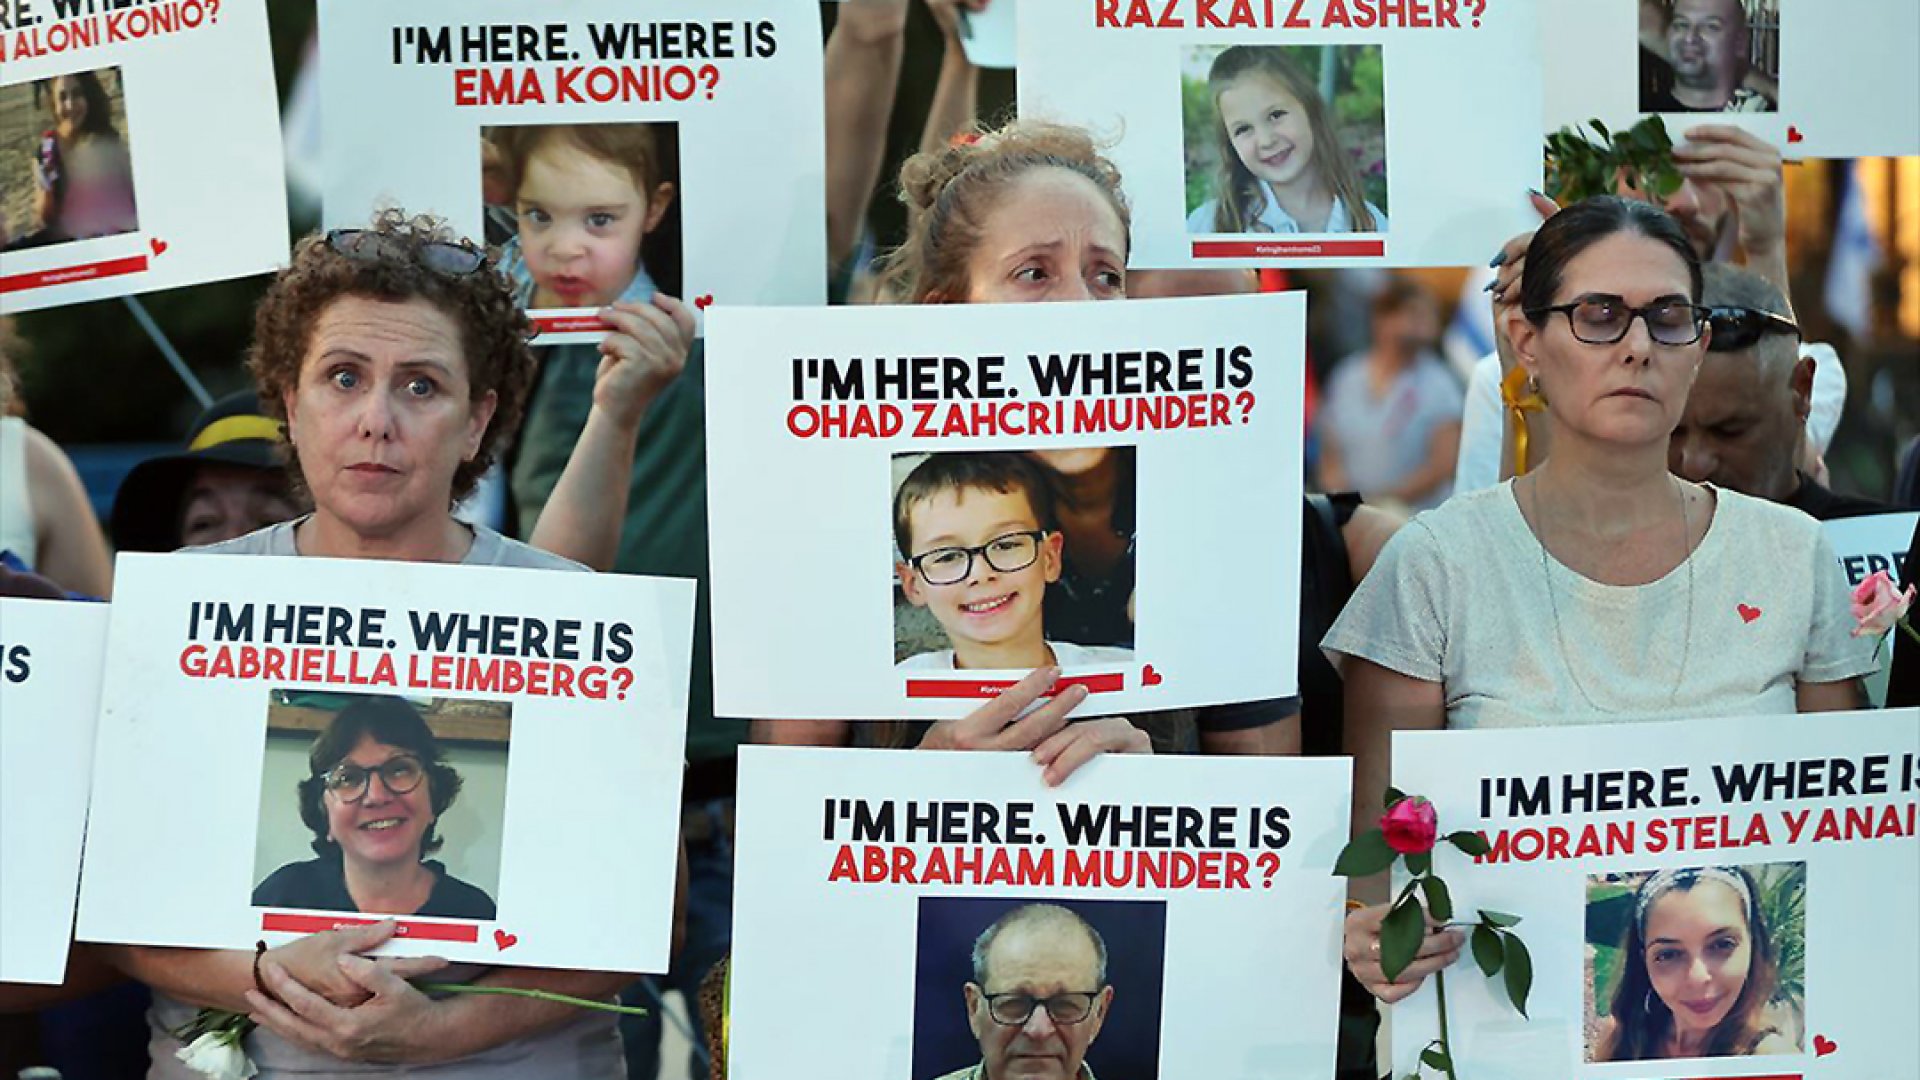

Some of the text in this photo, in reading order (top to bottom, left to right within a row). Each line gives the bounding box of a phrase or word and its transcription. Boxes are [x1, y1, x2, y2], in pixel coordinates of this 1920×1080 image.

[13, 18, 100, 60] ALONI
[105, 0, 221, 43] KONIO?
[1095, 0, 1486, 29] RAZ KATZ ASHER?
[392, 20, 776, 65] I'M HERE. WHERE IS
[454, 63, 719, 106] EMA KONIO?
[792, 345, 1253, 401] I'M HERE. WHERE IS
[787, 390, 1256, 439] OHAD ZAHCRI MUNDER?
[188, 601, 634, 664] I'M HERE. WHERE IS
[179, 644, 634, 701] GABRIELLA LEIMBERG?
[1480, 753, 1920, 818] I'M HERE. WHERE I
[824, 798, 1291, 850] I'M HERE. WHERE IS
[1473, 803, 1917, 865] MORAN STELA YANAI
[829, 844, 1281, 890] ABRAHAM MUNDER?
